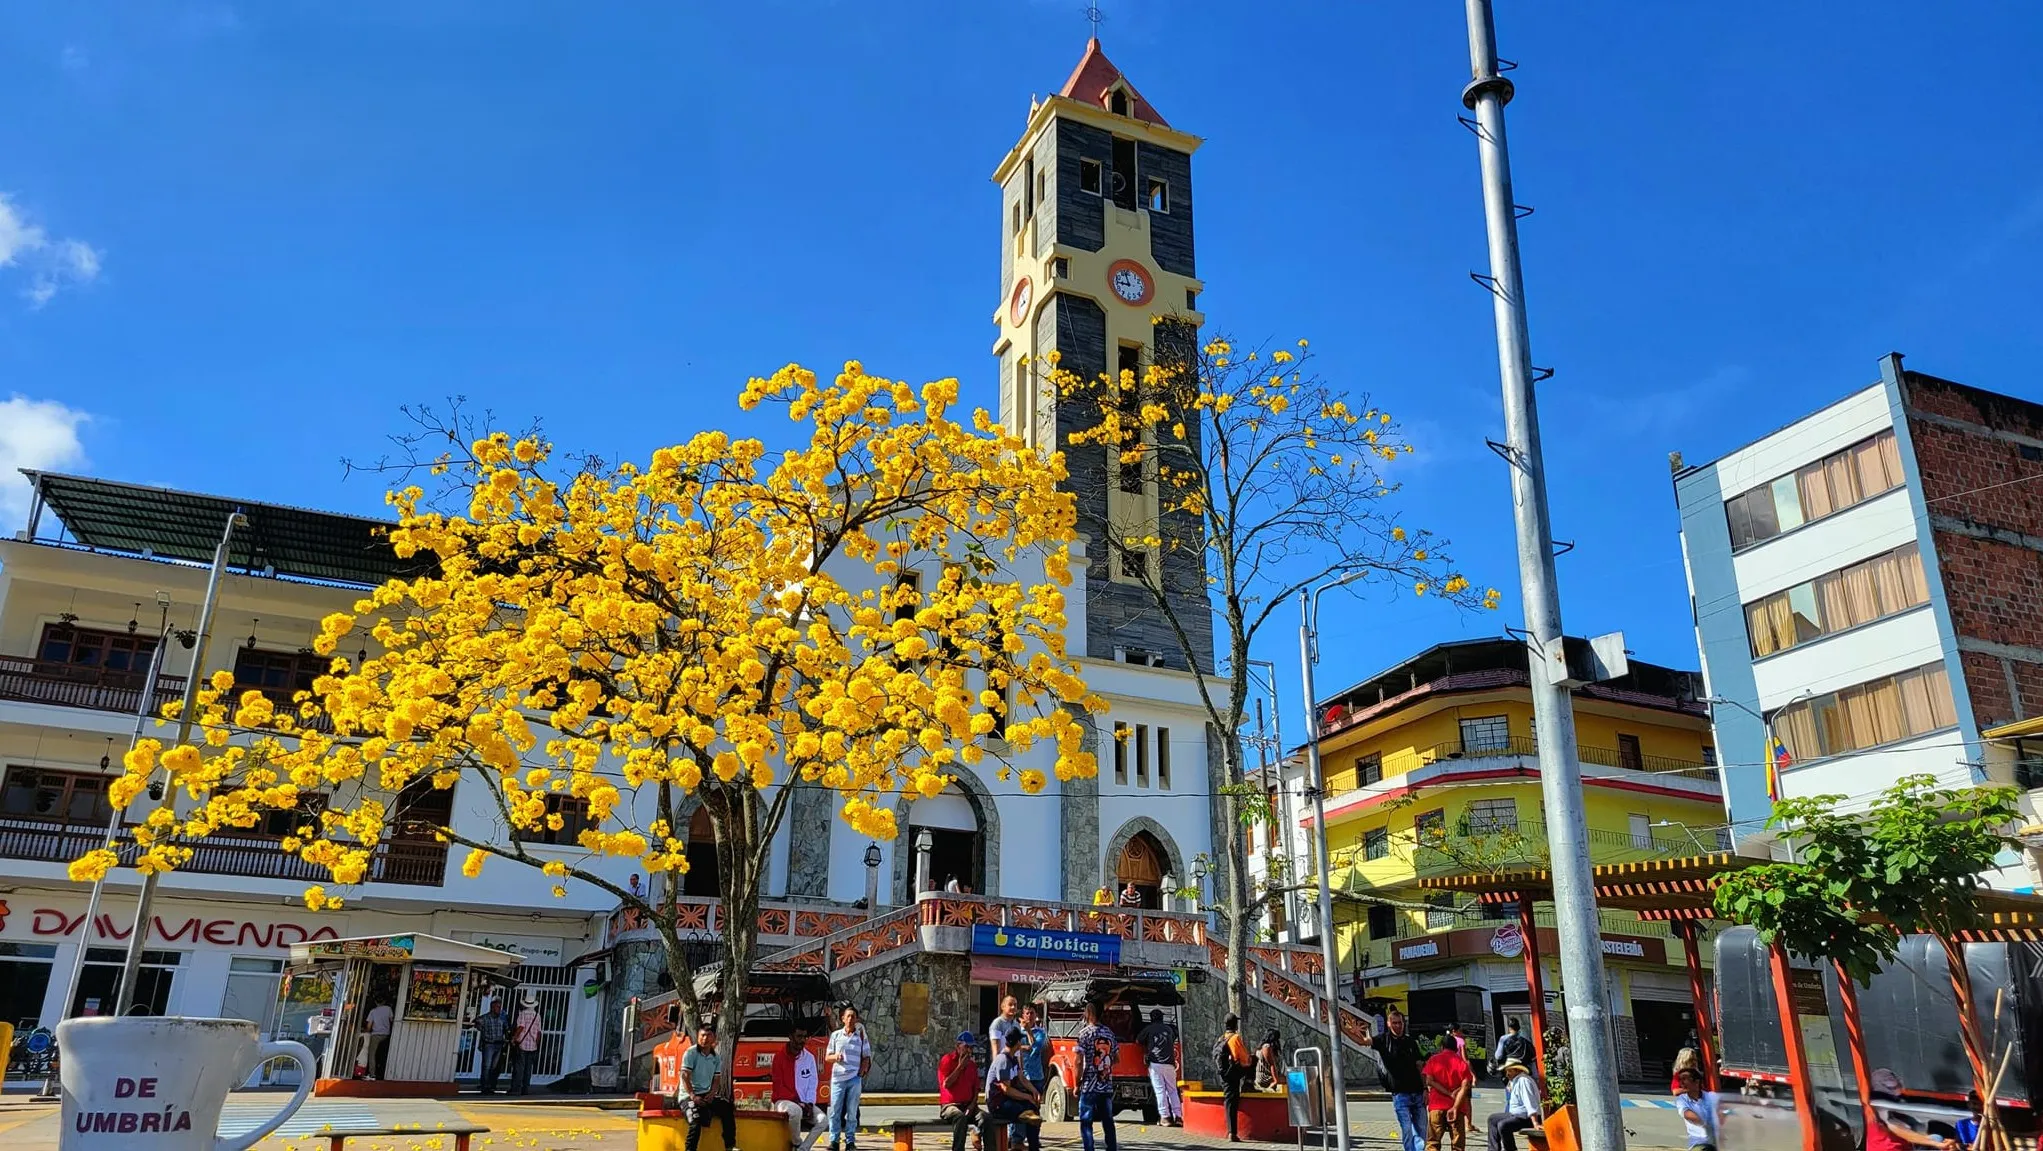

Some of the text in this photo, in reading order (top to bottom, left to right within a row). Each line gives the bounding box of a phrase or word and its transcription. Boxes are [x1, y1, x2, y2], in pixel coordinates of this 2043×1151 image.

[33, 907, 339, 949] DAVVIENDA
[1014, 934, 1099, 953] Su Botica
[1600, 940, 1644, 957] ASTELERÍA
[115, 1078, 158, 1098] DE
[76, 1104, 191, 1133] UMBRÍA
